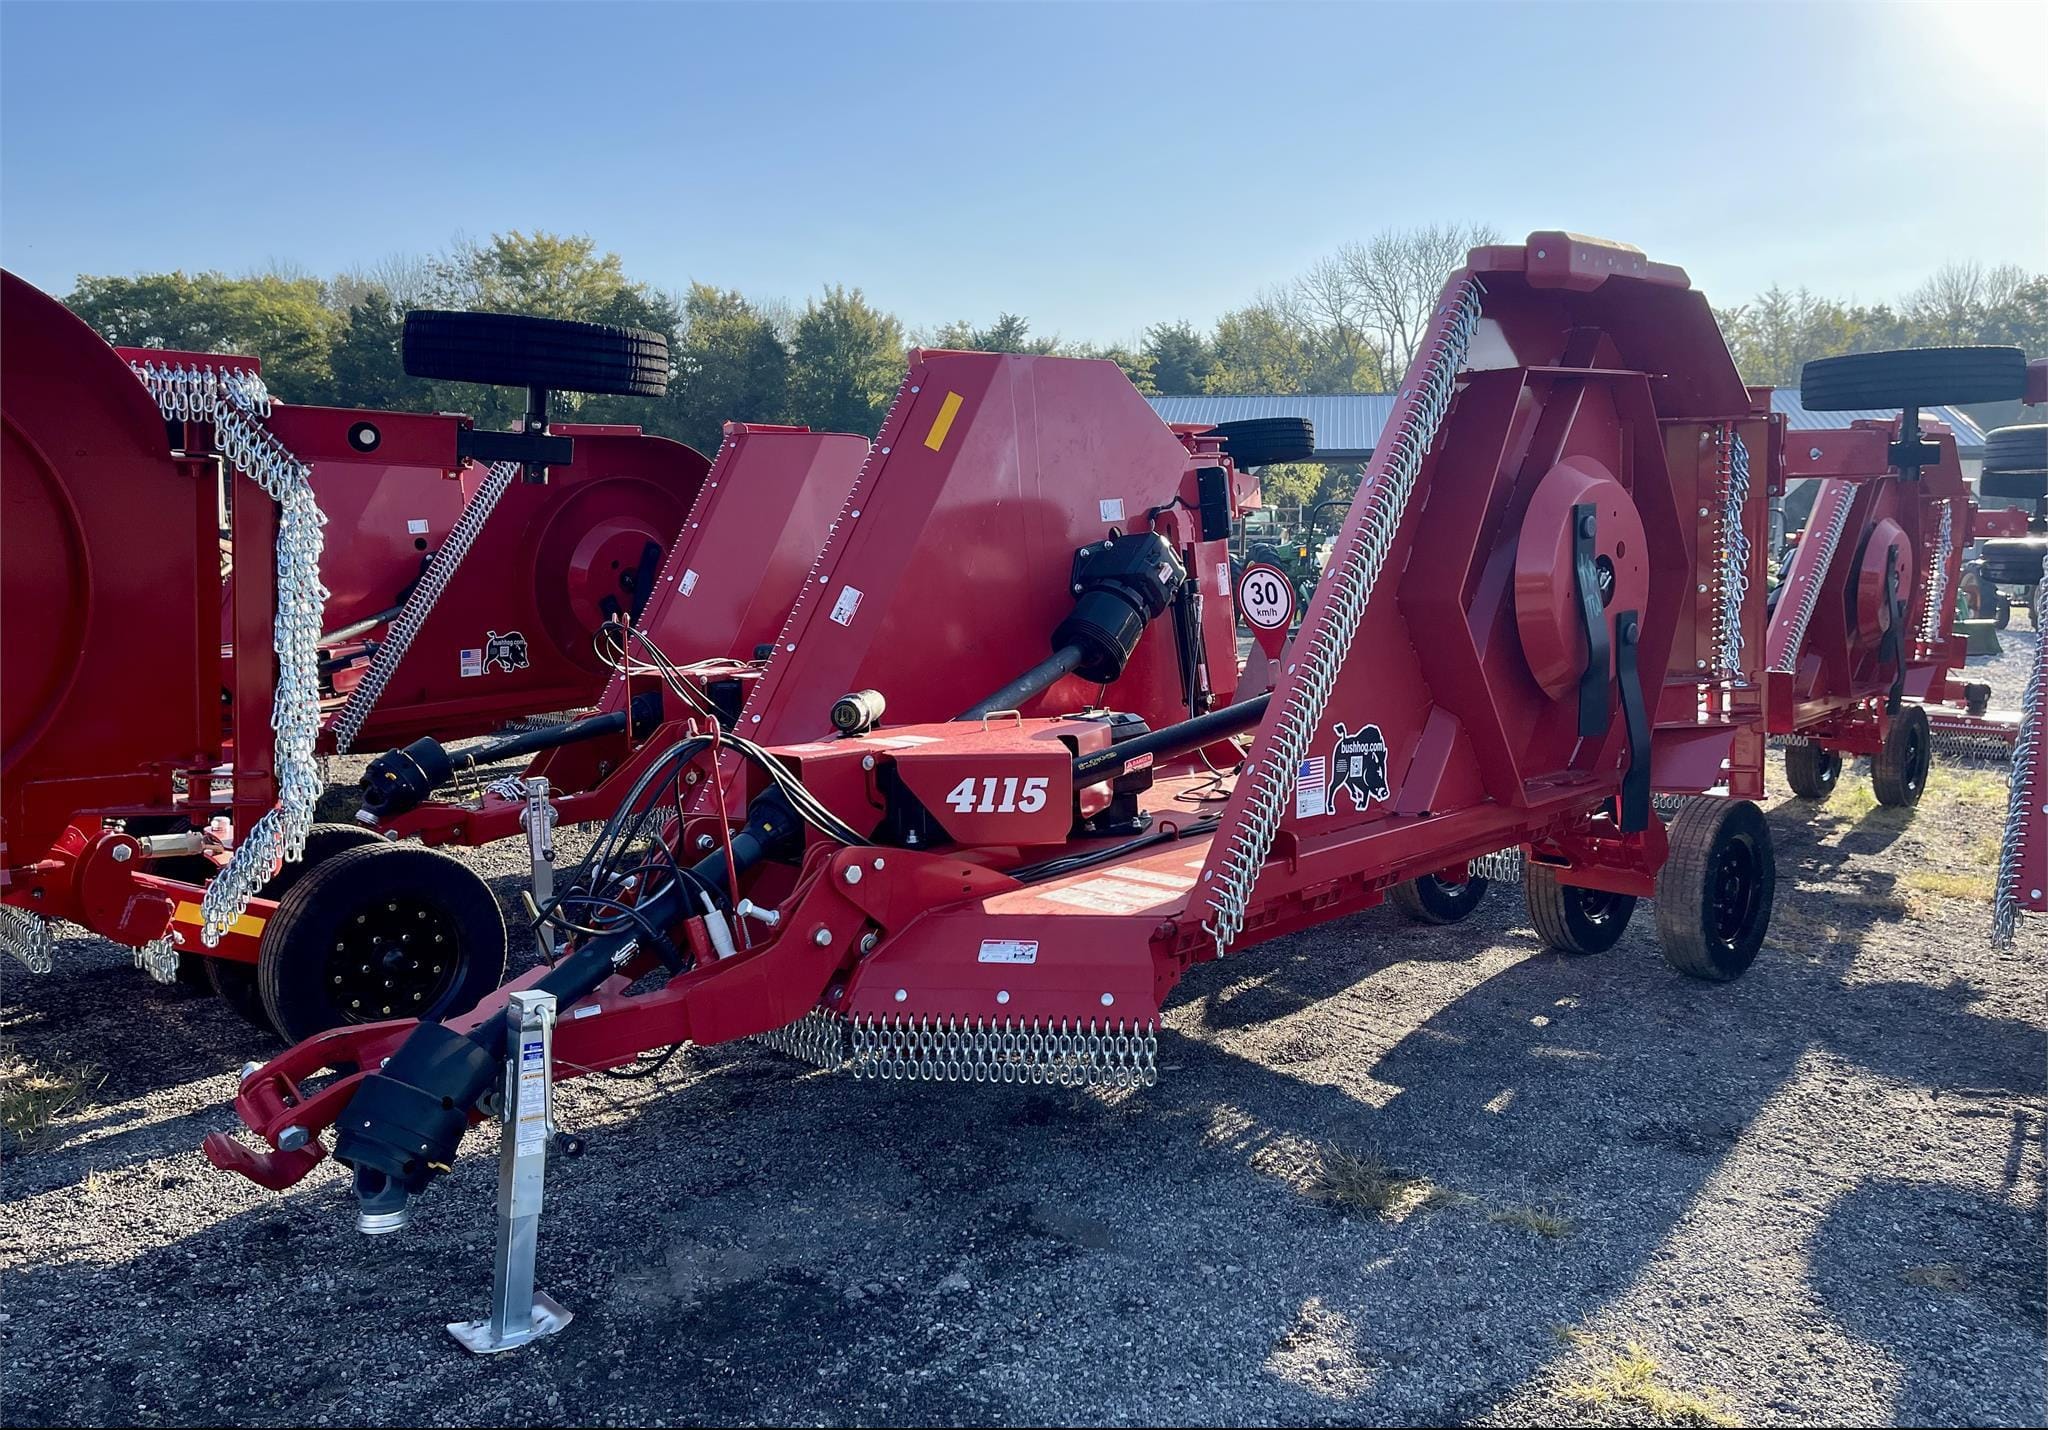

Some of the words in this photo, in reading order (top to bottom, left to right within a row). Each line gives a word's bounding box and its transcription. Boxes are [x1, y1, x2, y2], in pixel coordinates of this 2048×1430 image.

[1250, 581, 1278, 605] 30
[1256, 608, 1278, 617] km/h
[1341, 741, 1383, 756] bushhog.com
[945, 777, 1050, 813] 4115
